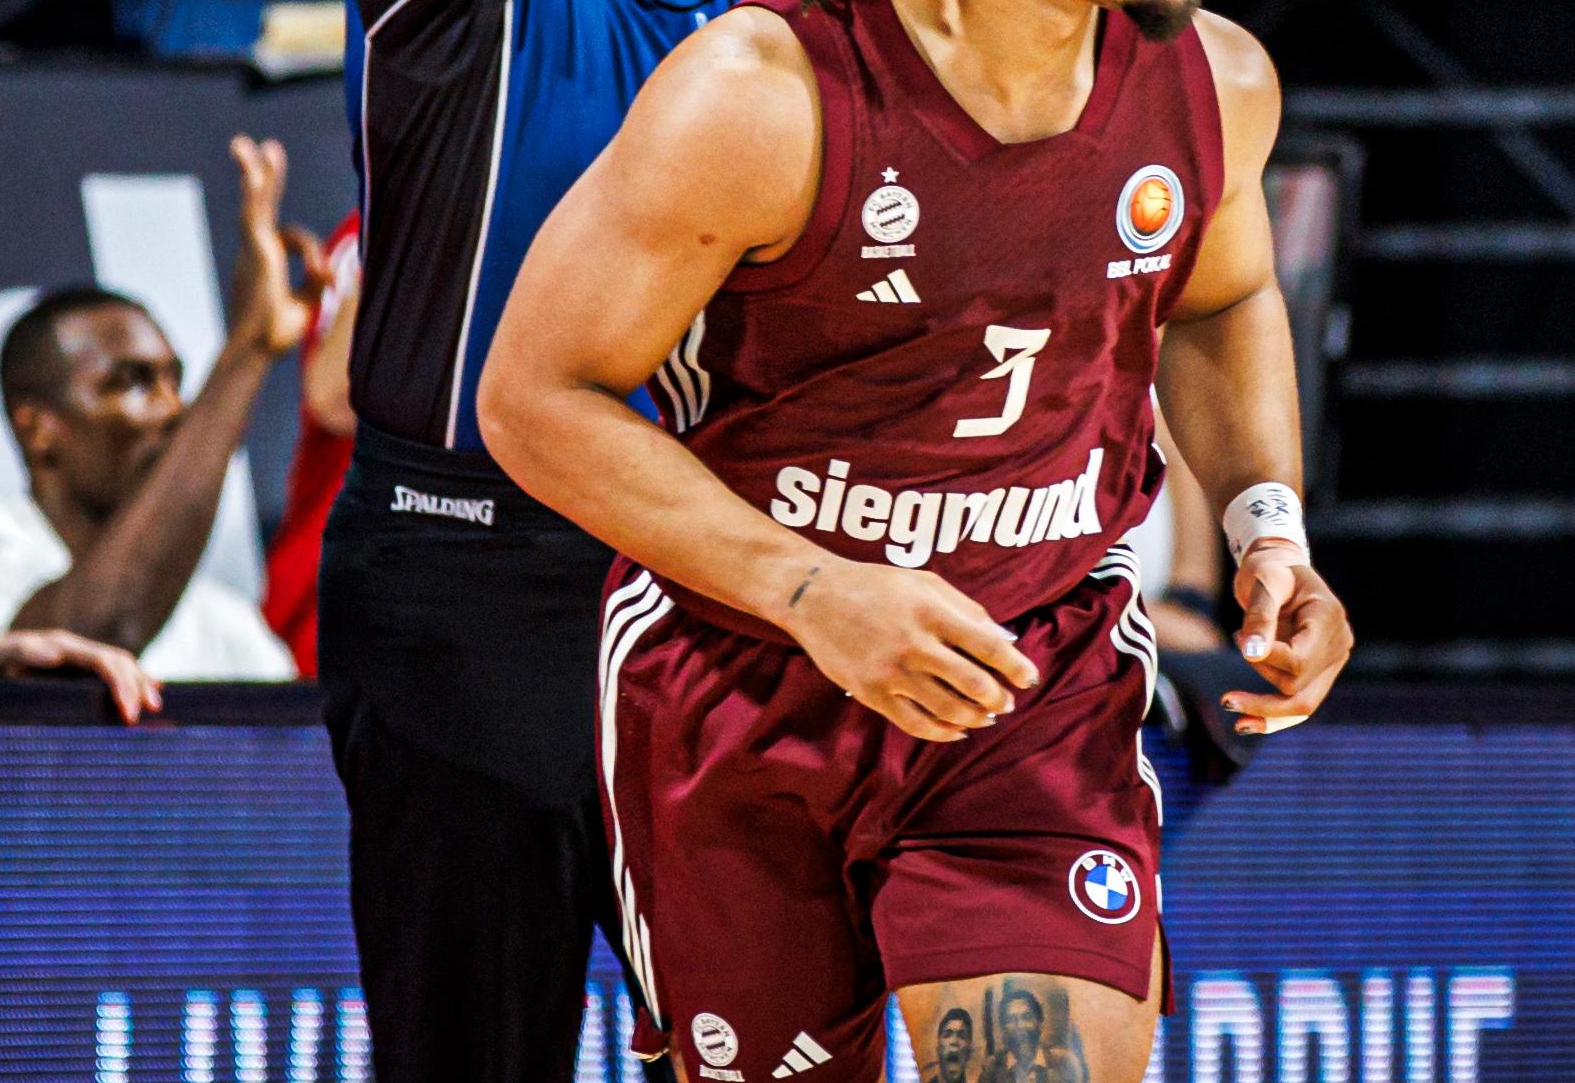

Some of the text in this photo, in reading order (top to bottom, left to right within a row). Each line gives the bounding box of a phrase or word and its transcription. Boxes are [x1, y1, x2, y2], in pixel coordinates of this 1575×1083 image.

[953, 324, 1052, 438] 3
[390, 485, 495, 526] SPALDING
[770, 447, 1105, 568] siegmund
